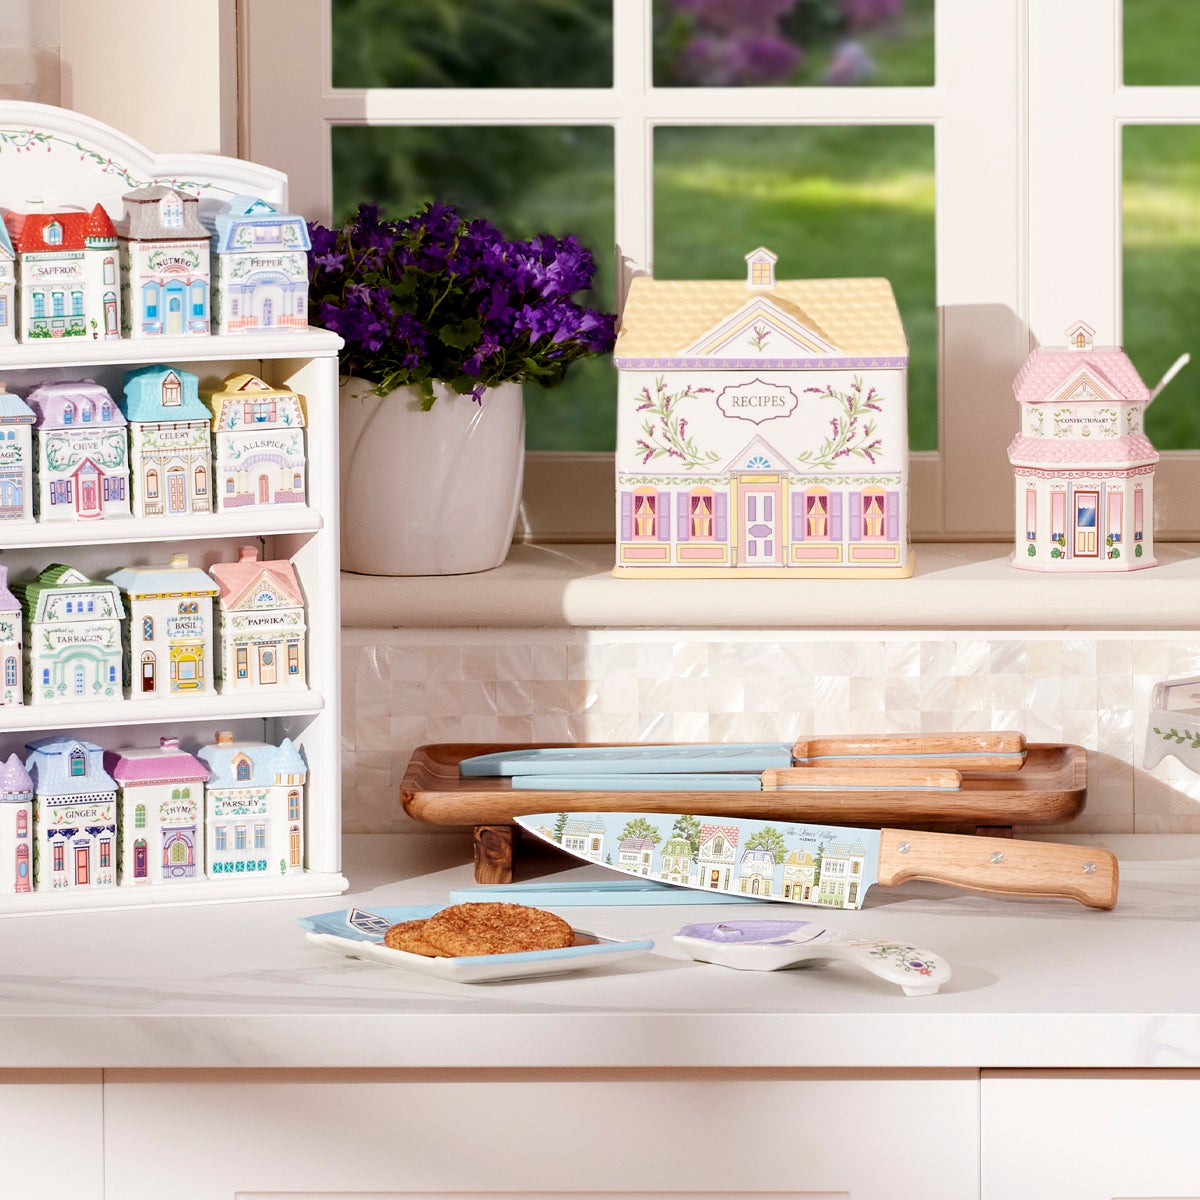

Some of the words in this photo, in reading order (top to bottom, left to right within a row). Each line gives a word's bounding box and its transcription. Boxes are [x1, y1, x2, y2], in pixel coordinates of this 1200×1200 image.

[156, 257, 192, 269] NUTMEG
[250, 258, 283, 267] PEPPER
[37, 266, 77, 275] SAFFRON
[731, 394, 787, 409] RECIPES
[159, 431, 190, 440] CELERY
[72, 442, 99, 451] CHIVE
[243, 440, 286, 452] ALLSPICE
[175, 621, 198, 630] BASIL
[248, 617, 285, 626] PAPRIKA
[56, 634, 103, 644] TARRAGON
[222, 799, 259, 808] PARSLEY
[65, 809, 97, 819] GINGER
[165, 805, 193, 816] THYME
